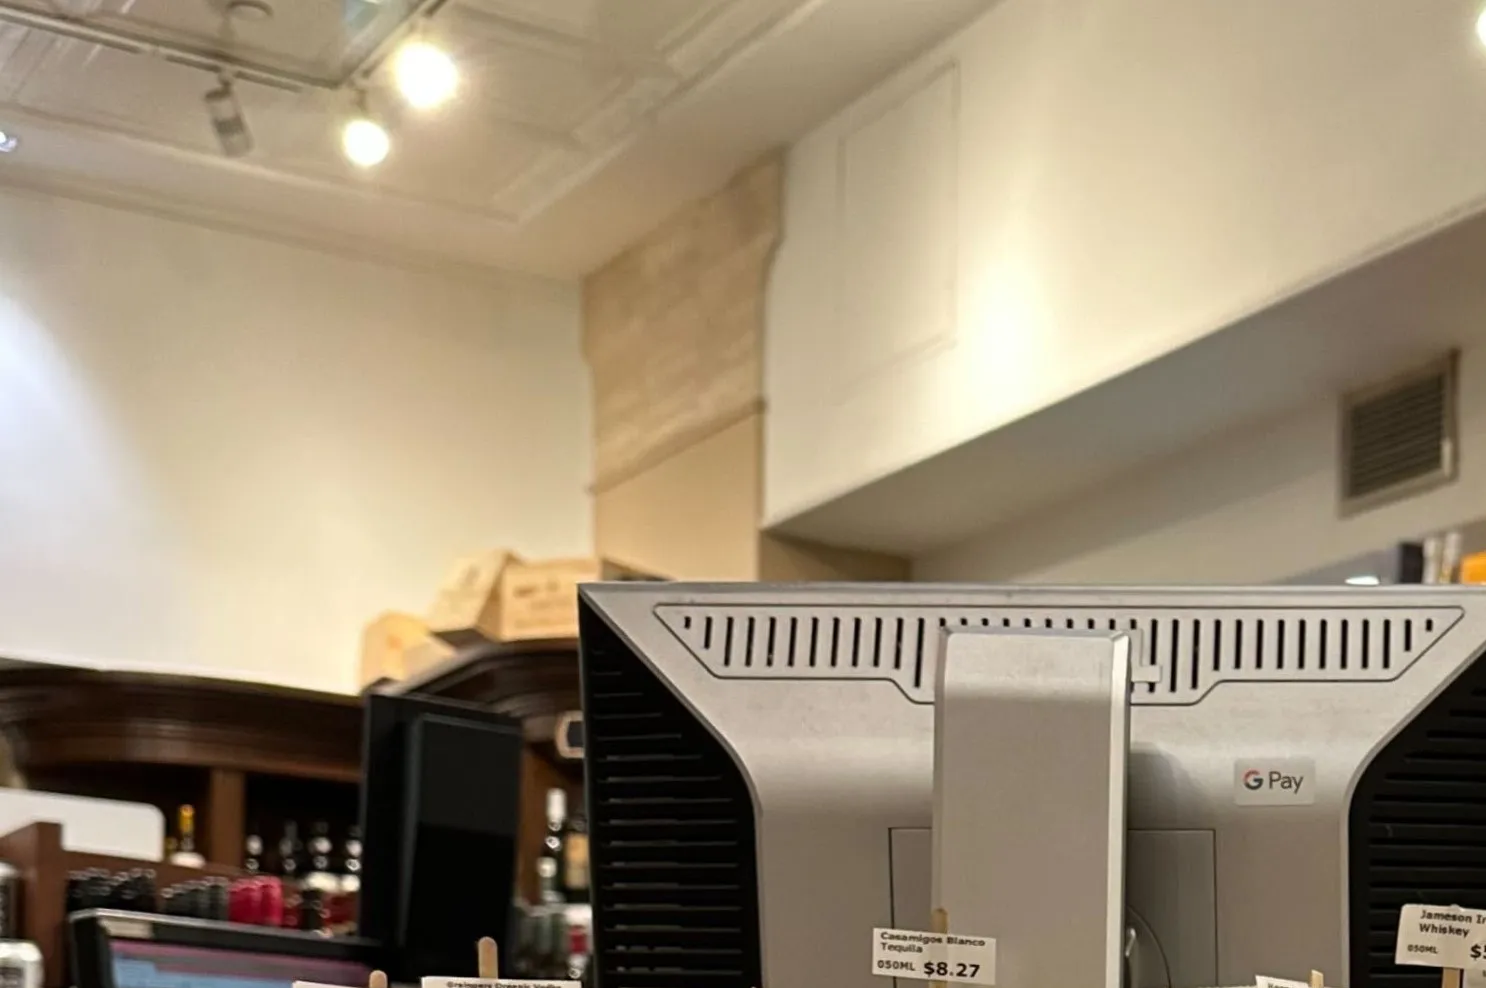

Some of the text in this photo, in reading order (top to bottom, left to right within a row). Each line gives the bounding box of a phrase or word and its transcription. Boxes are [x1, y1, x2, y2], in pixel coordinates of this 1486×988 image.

[1268, 770, 1304, 795] Pay
[1419, 910, 1473, 924] Jameson
[880, 931, 986, 947] Casamigos Blanco
[1418, 923, 1469, 939] Whiskey
[880, 942, 924, 954] Tequila
[877, 960, 980, 978] 050ML $8.27
